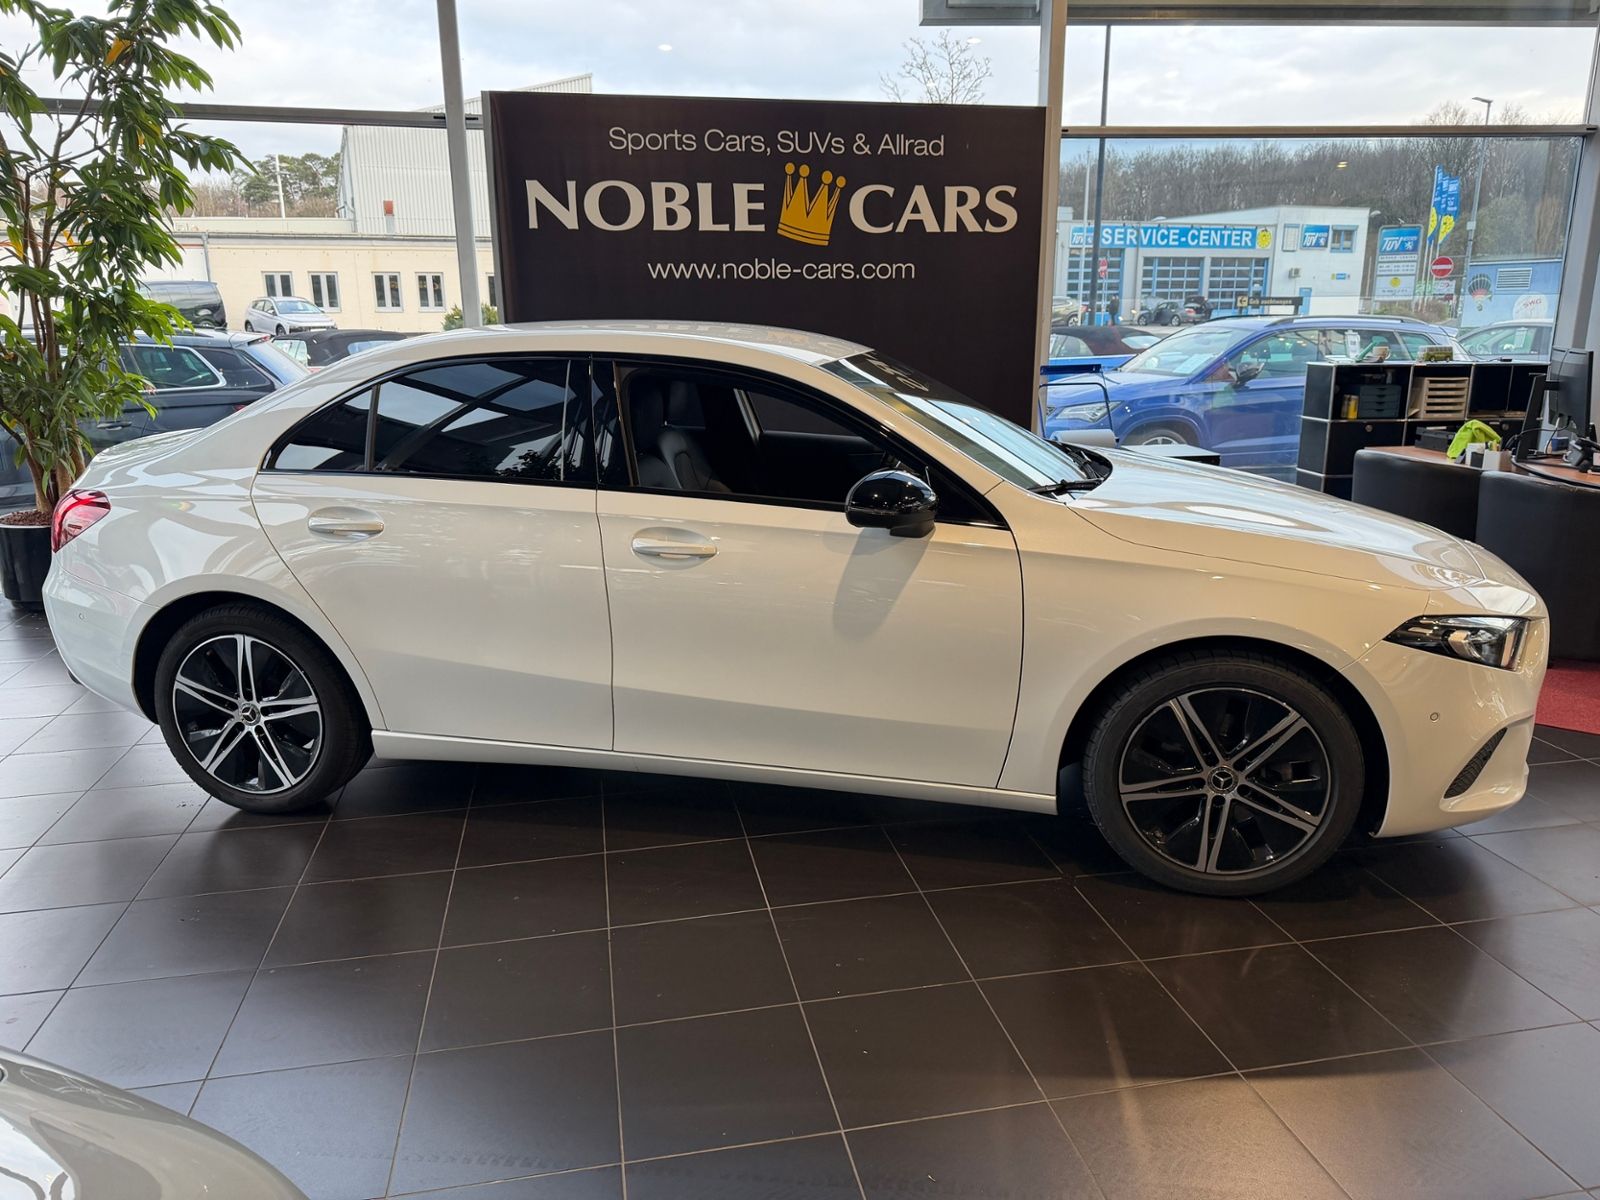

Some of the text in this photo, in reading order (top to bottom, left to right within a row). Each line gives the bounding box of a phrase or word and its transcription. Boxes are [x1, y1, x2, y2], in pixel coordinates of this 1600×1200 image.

[608, 126, 945, 157] Sports Cars, SUVs & Allrad
[525, 179, 1018, 234] NOBLE CARS
[1101, 228, 1252, 247] SERVICE-CENTER
[647, 257, 915, 280] www.noble-cars.com
